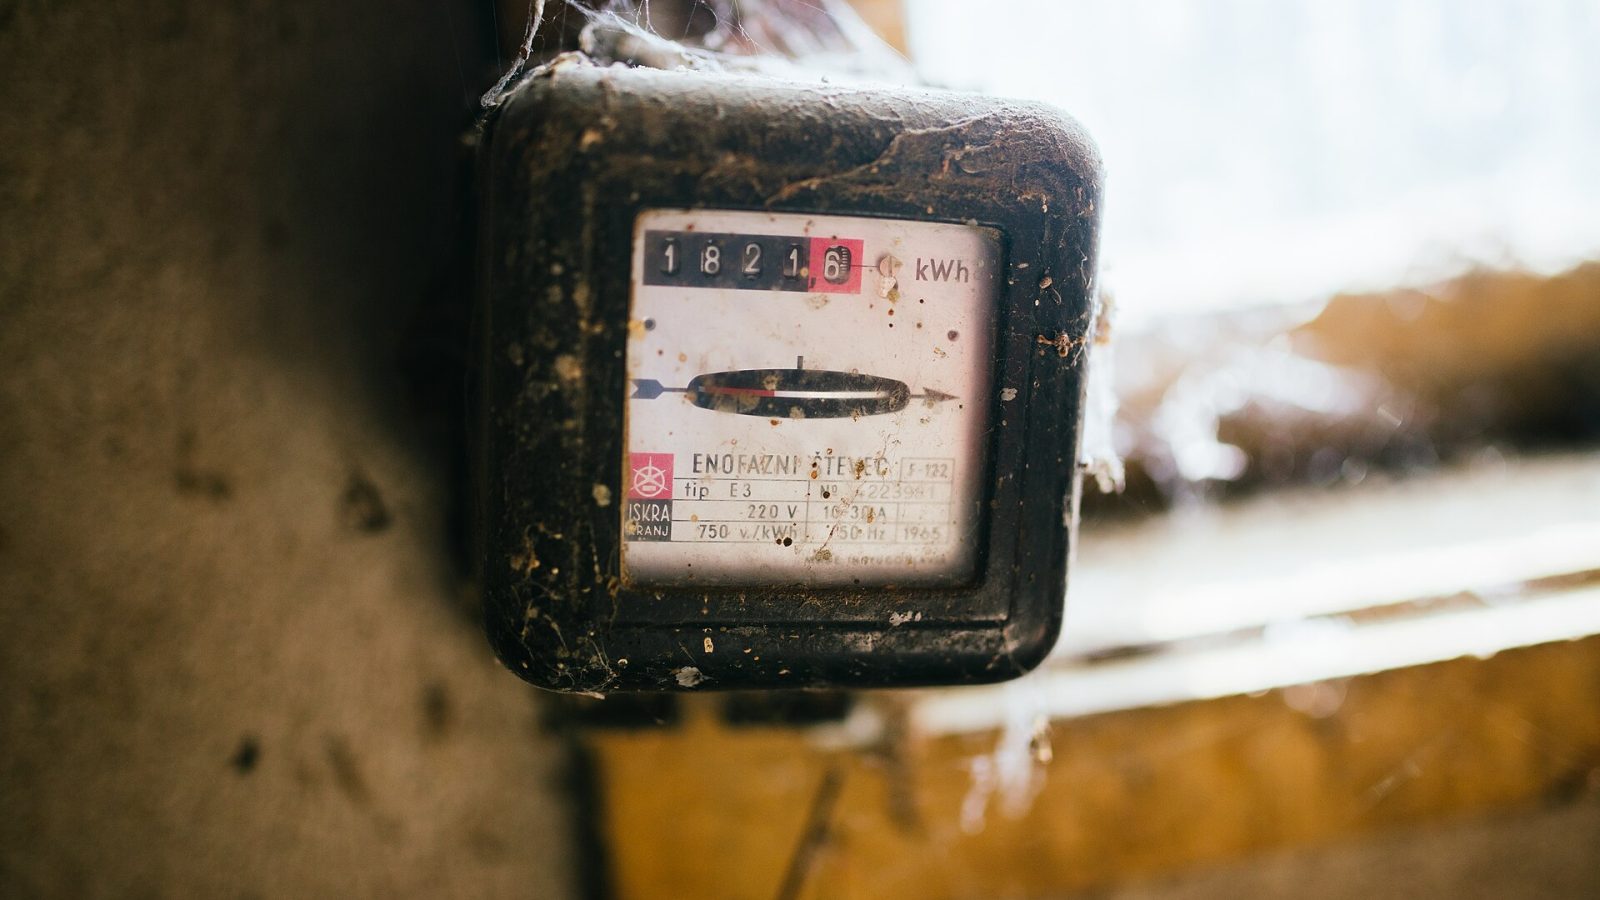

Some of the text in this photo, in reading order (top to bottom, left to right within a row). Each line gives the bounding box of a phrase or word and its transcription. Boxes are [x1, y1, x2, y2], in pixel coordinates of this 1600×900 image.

[915, 257, 969, 283] kWh
[692, 453, 798, 476] ENOFAZNI
[684, 482, 710, 500] tip
[628, 502, 670, 522] ISKRA
[747, 504, 798, 519] 220 V
[877, 506, 887, 520] A
[700, 524, 729, 539] 750
[839, 525, 942, 541] 50 Hz 1965
